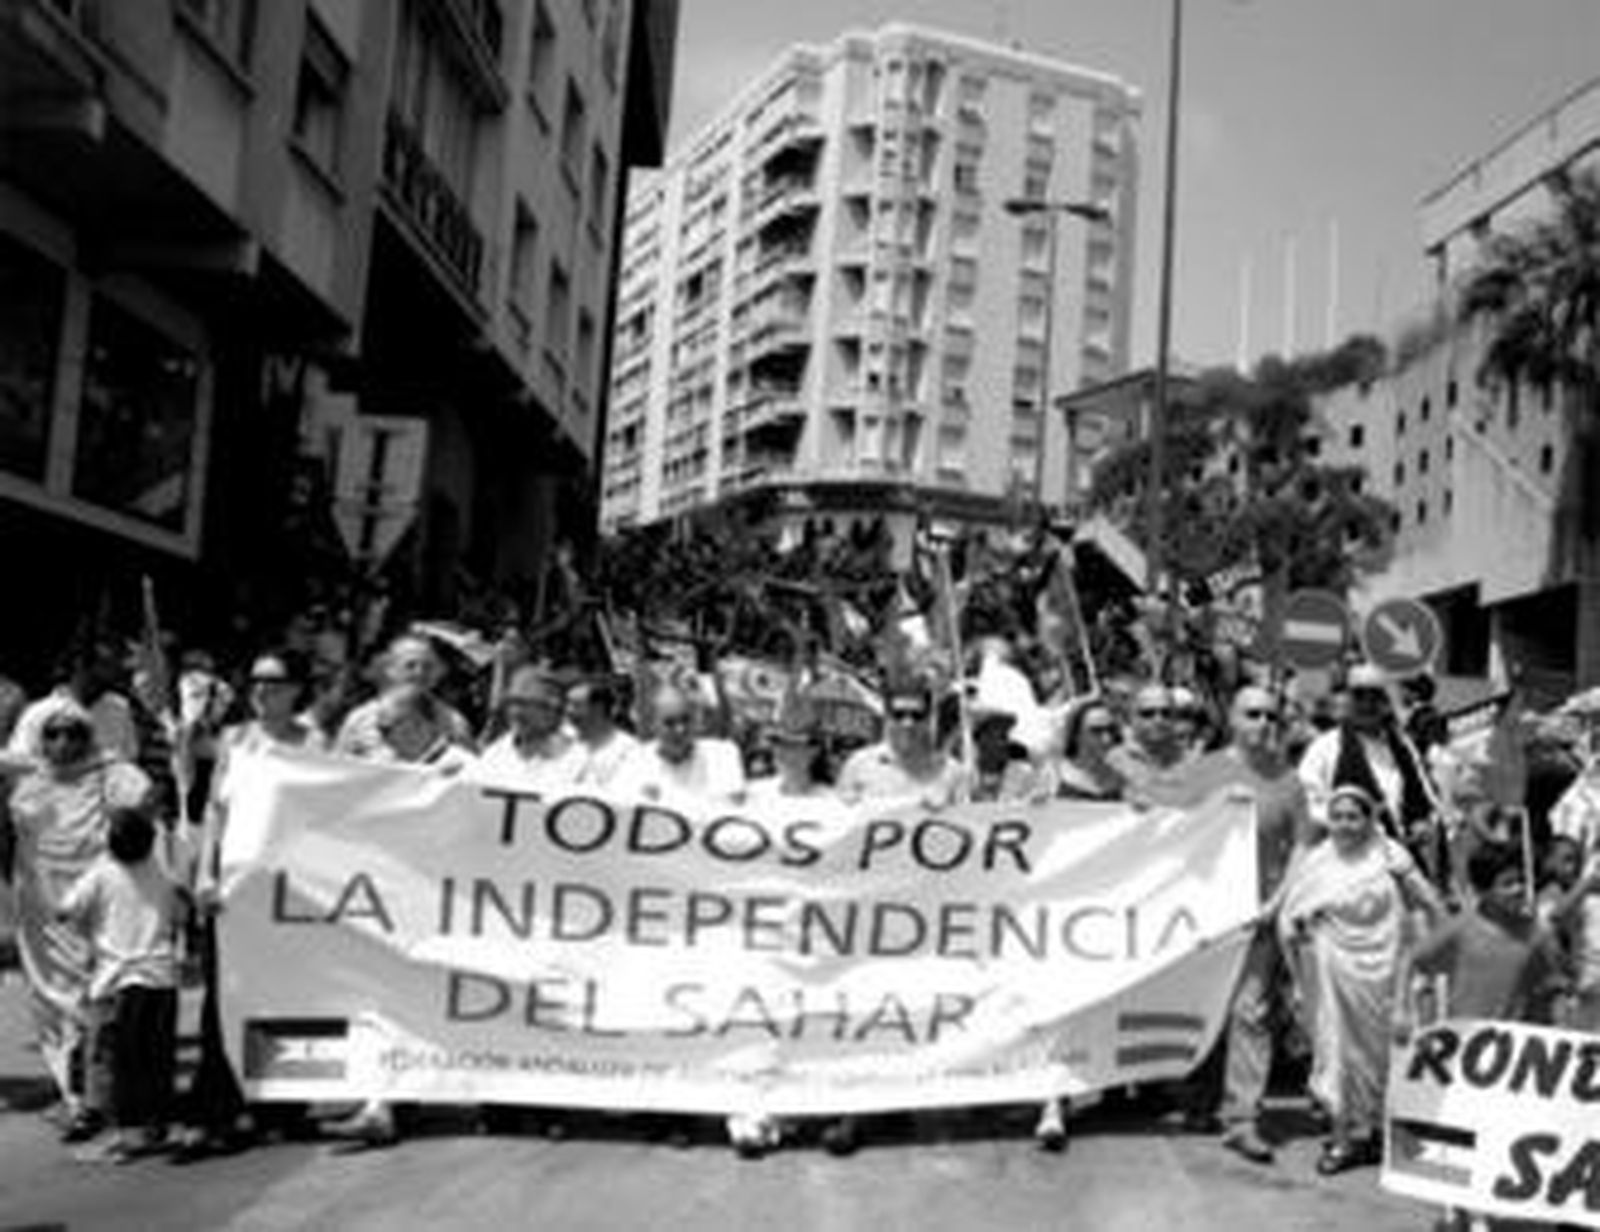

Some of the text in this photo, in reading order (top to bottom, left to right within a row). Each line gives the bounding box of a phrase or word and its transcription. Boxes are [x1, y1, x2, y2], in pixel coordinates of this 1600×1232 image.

[481, 788, 1031, 872] TODOS POR
[272, 870, 1198, 962] LA INDEPENDENCIA
[447, 970, 1000, 1043] DEL SAHAR
